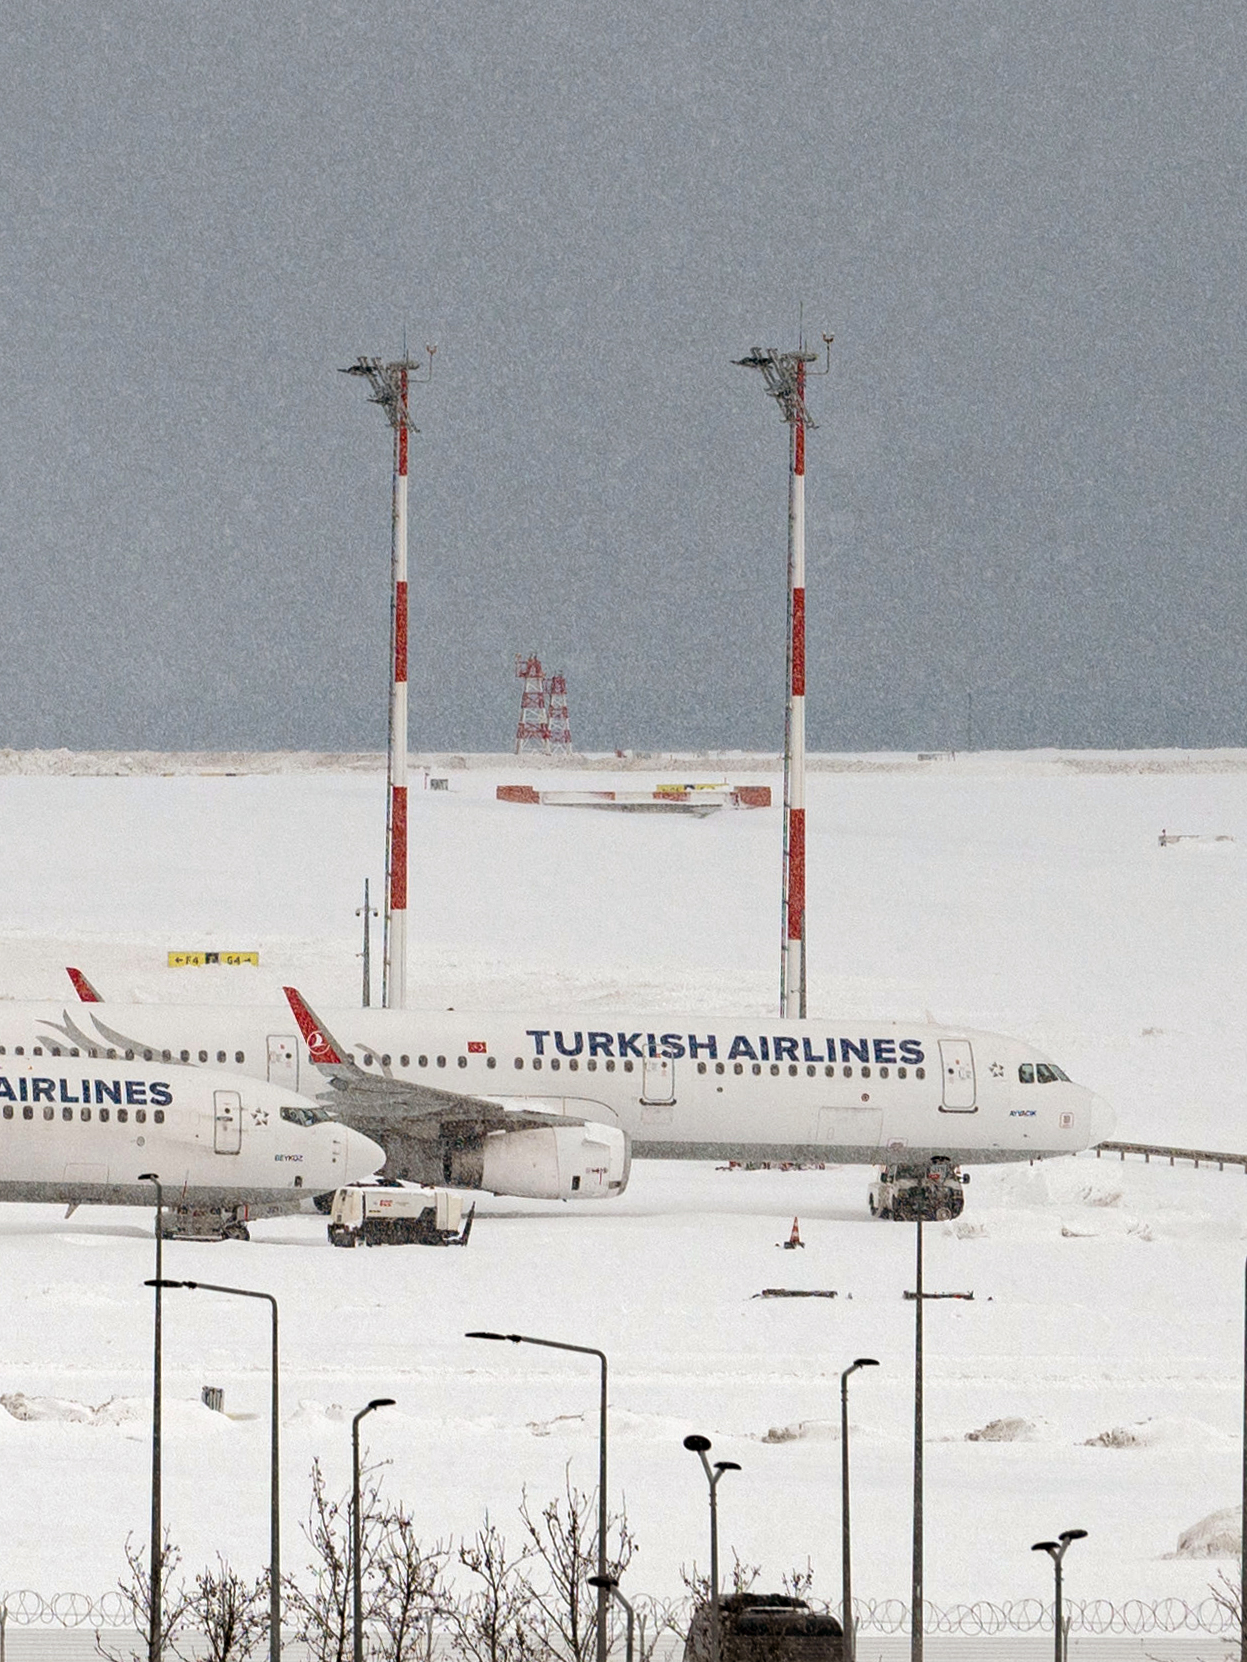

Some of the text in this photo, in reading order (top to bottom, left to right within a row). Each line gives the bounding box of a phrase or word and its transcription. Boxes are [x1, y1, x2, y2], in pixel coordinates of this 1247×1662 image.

[227, 955, 241, 965] G4
[526, 1029, 926, 1065] TURKISH AIRLINES
